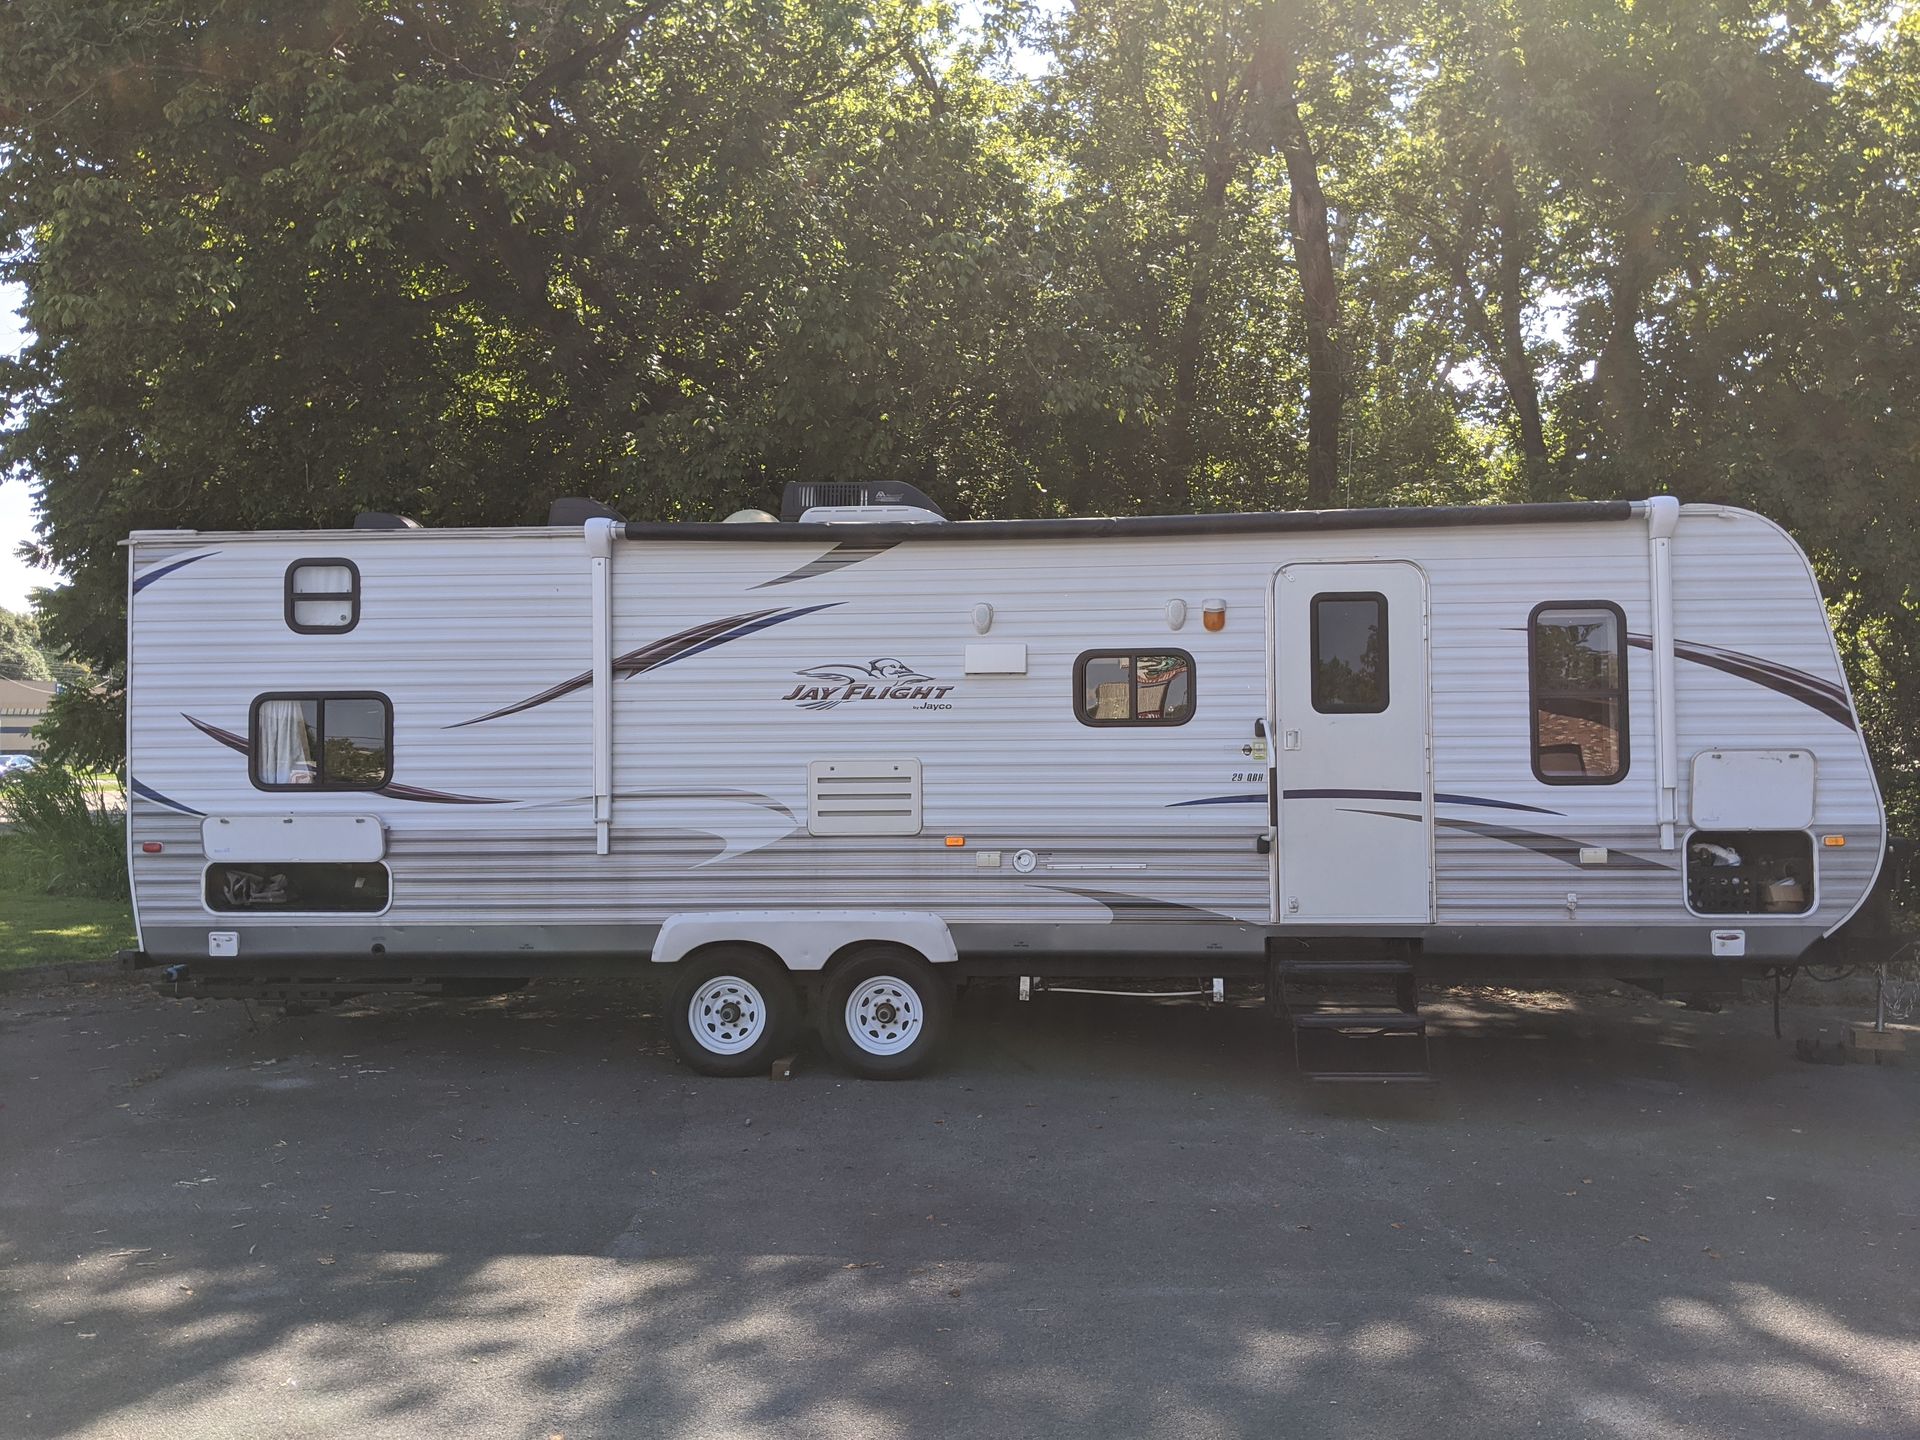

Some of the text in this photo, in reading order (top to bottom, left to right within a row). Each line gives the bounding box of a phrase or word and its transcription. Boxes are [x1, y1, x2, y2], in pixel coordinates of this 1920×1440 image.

[782, 684, 955, 700] JAY FLIGHT
[920, 702, 952, 711] Jayco
[1232, 773, 1243, 782] 29
